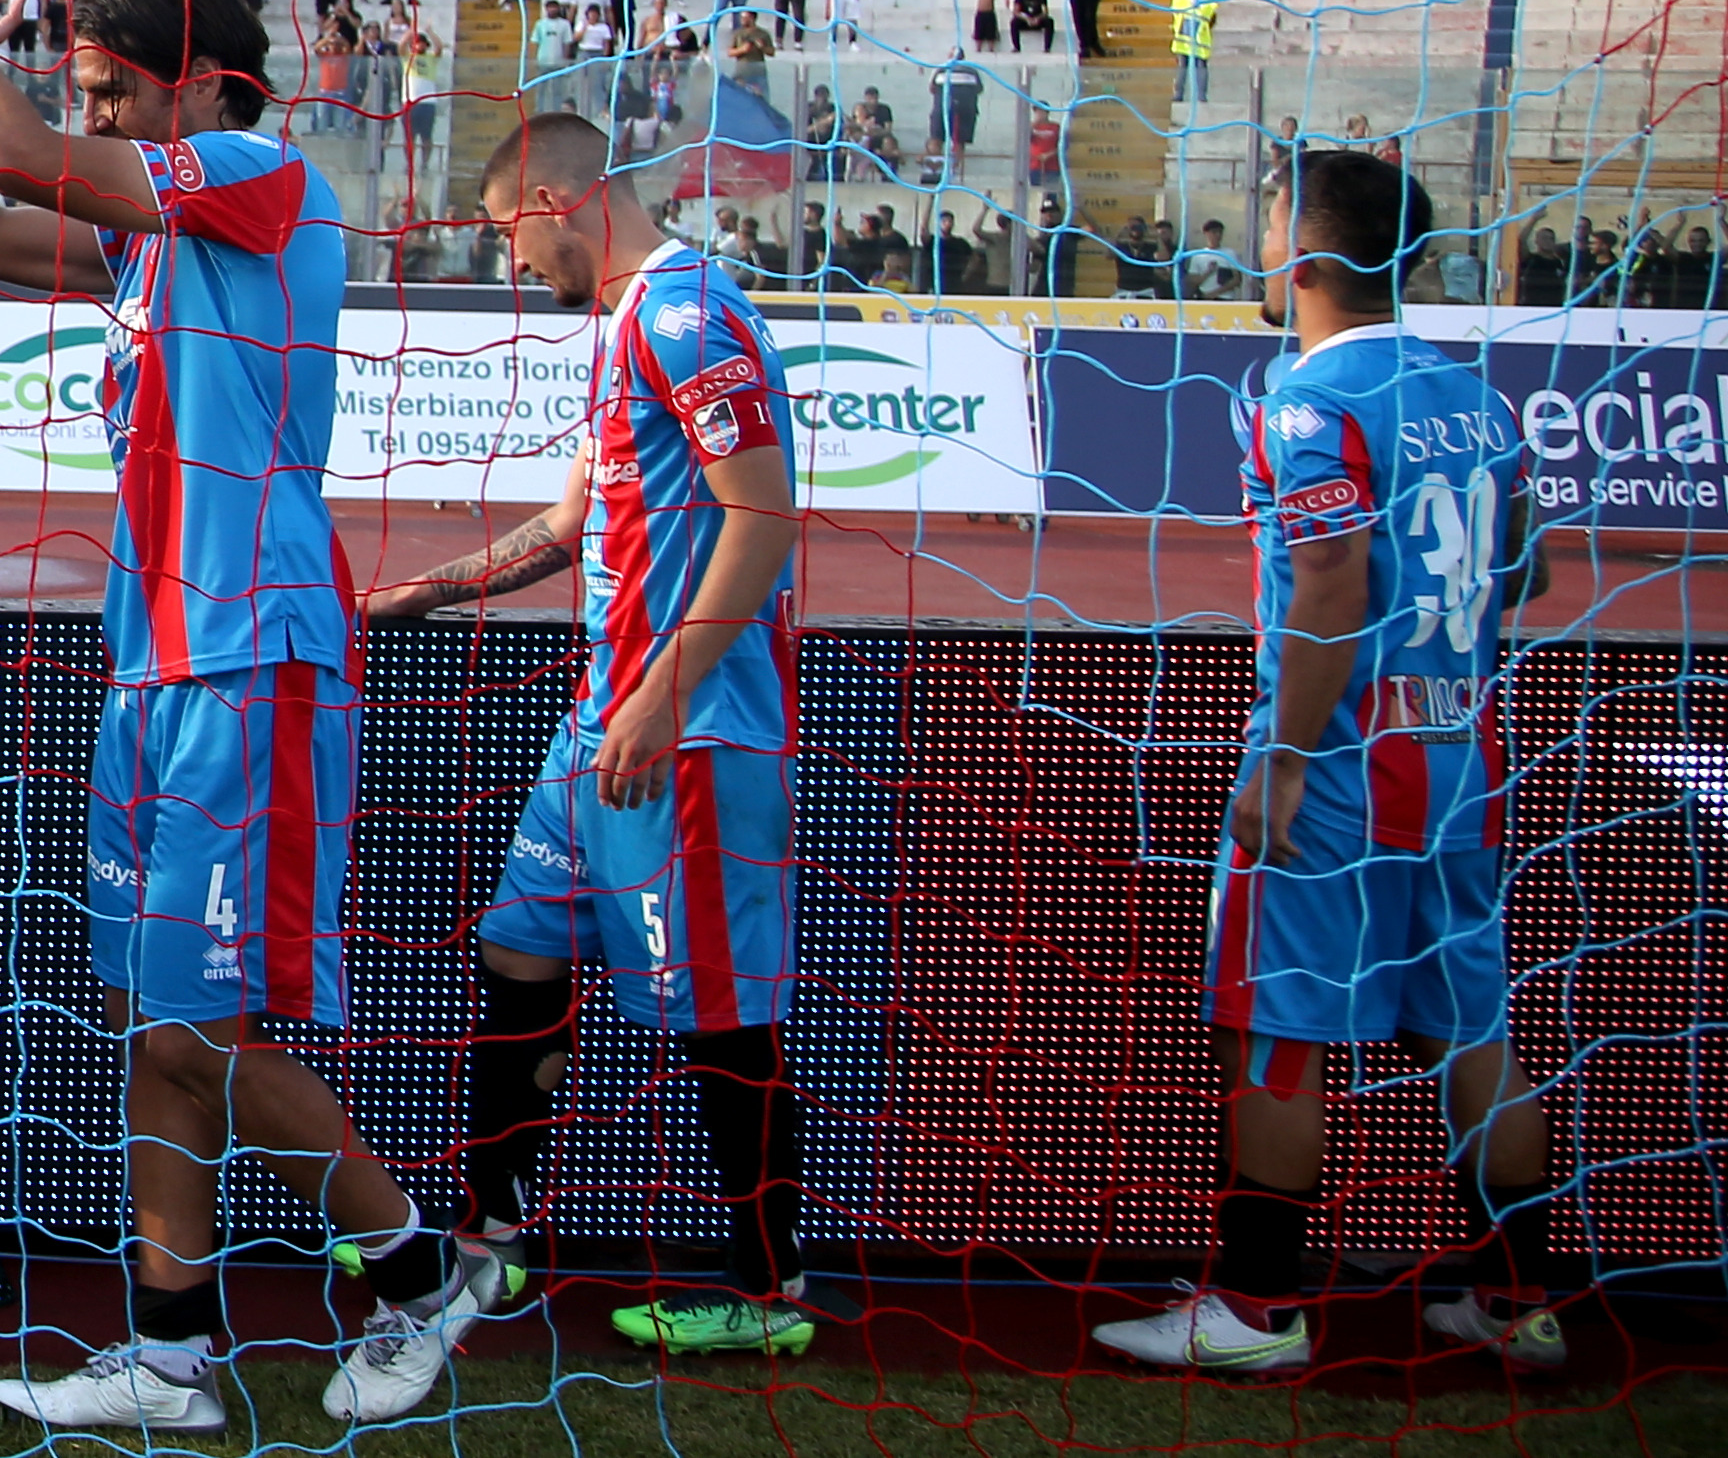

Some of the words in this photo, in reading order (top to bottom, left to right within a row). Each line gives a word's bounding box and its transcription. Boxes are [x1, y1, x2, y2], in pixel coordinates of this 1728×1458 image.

[350, 352, 492, 379] Vincenzo
[502, 355, 591, 382] Florio
[334, 390, 533, 419] Misterbianco
[543, 395, 591, 425] (CT
[793, 385, 986, 433] center
[362, 428, 406, 454] Tel
[1589, 472, 1718, 508] service
[1402, 466, 1497, 654] 30
[204, 863, 238, 937] 4
[640, 891, 667, 958] 5
